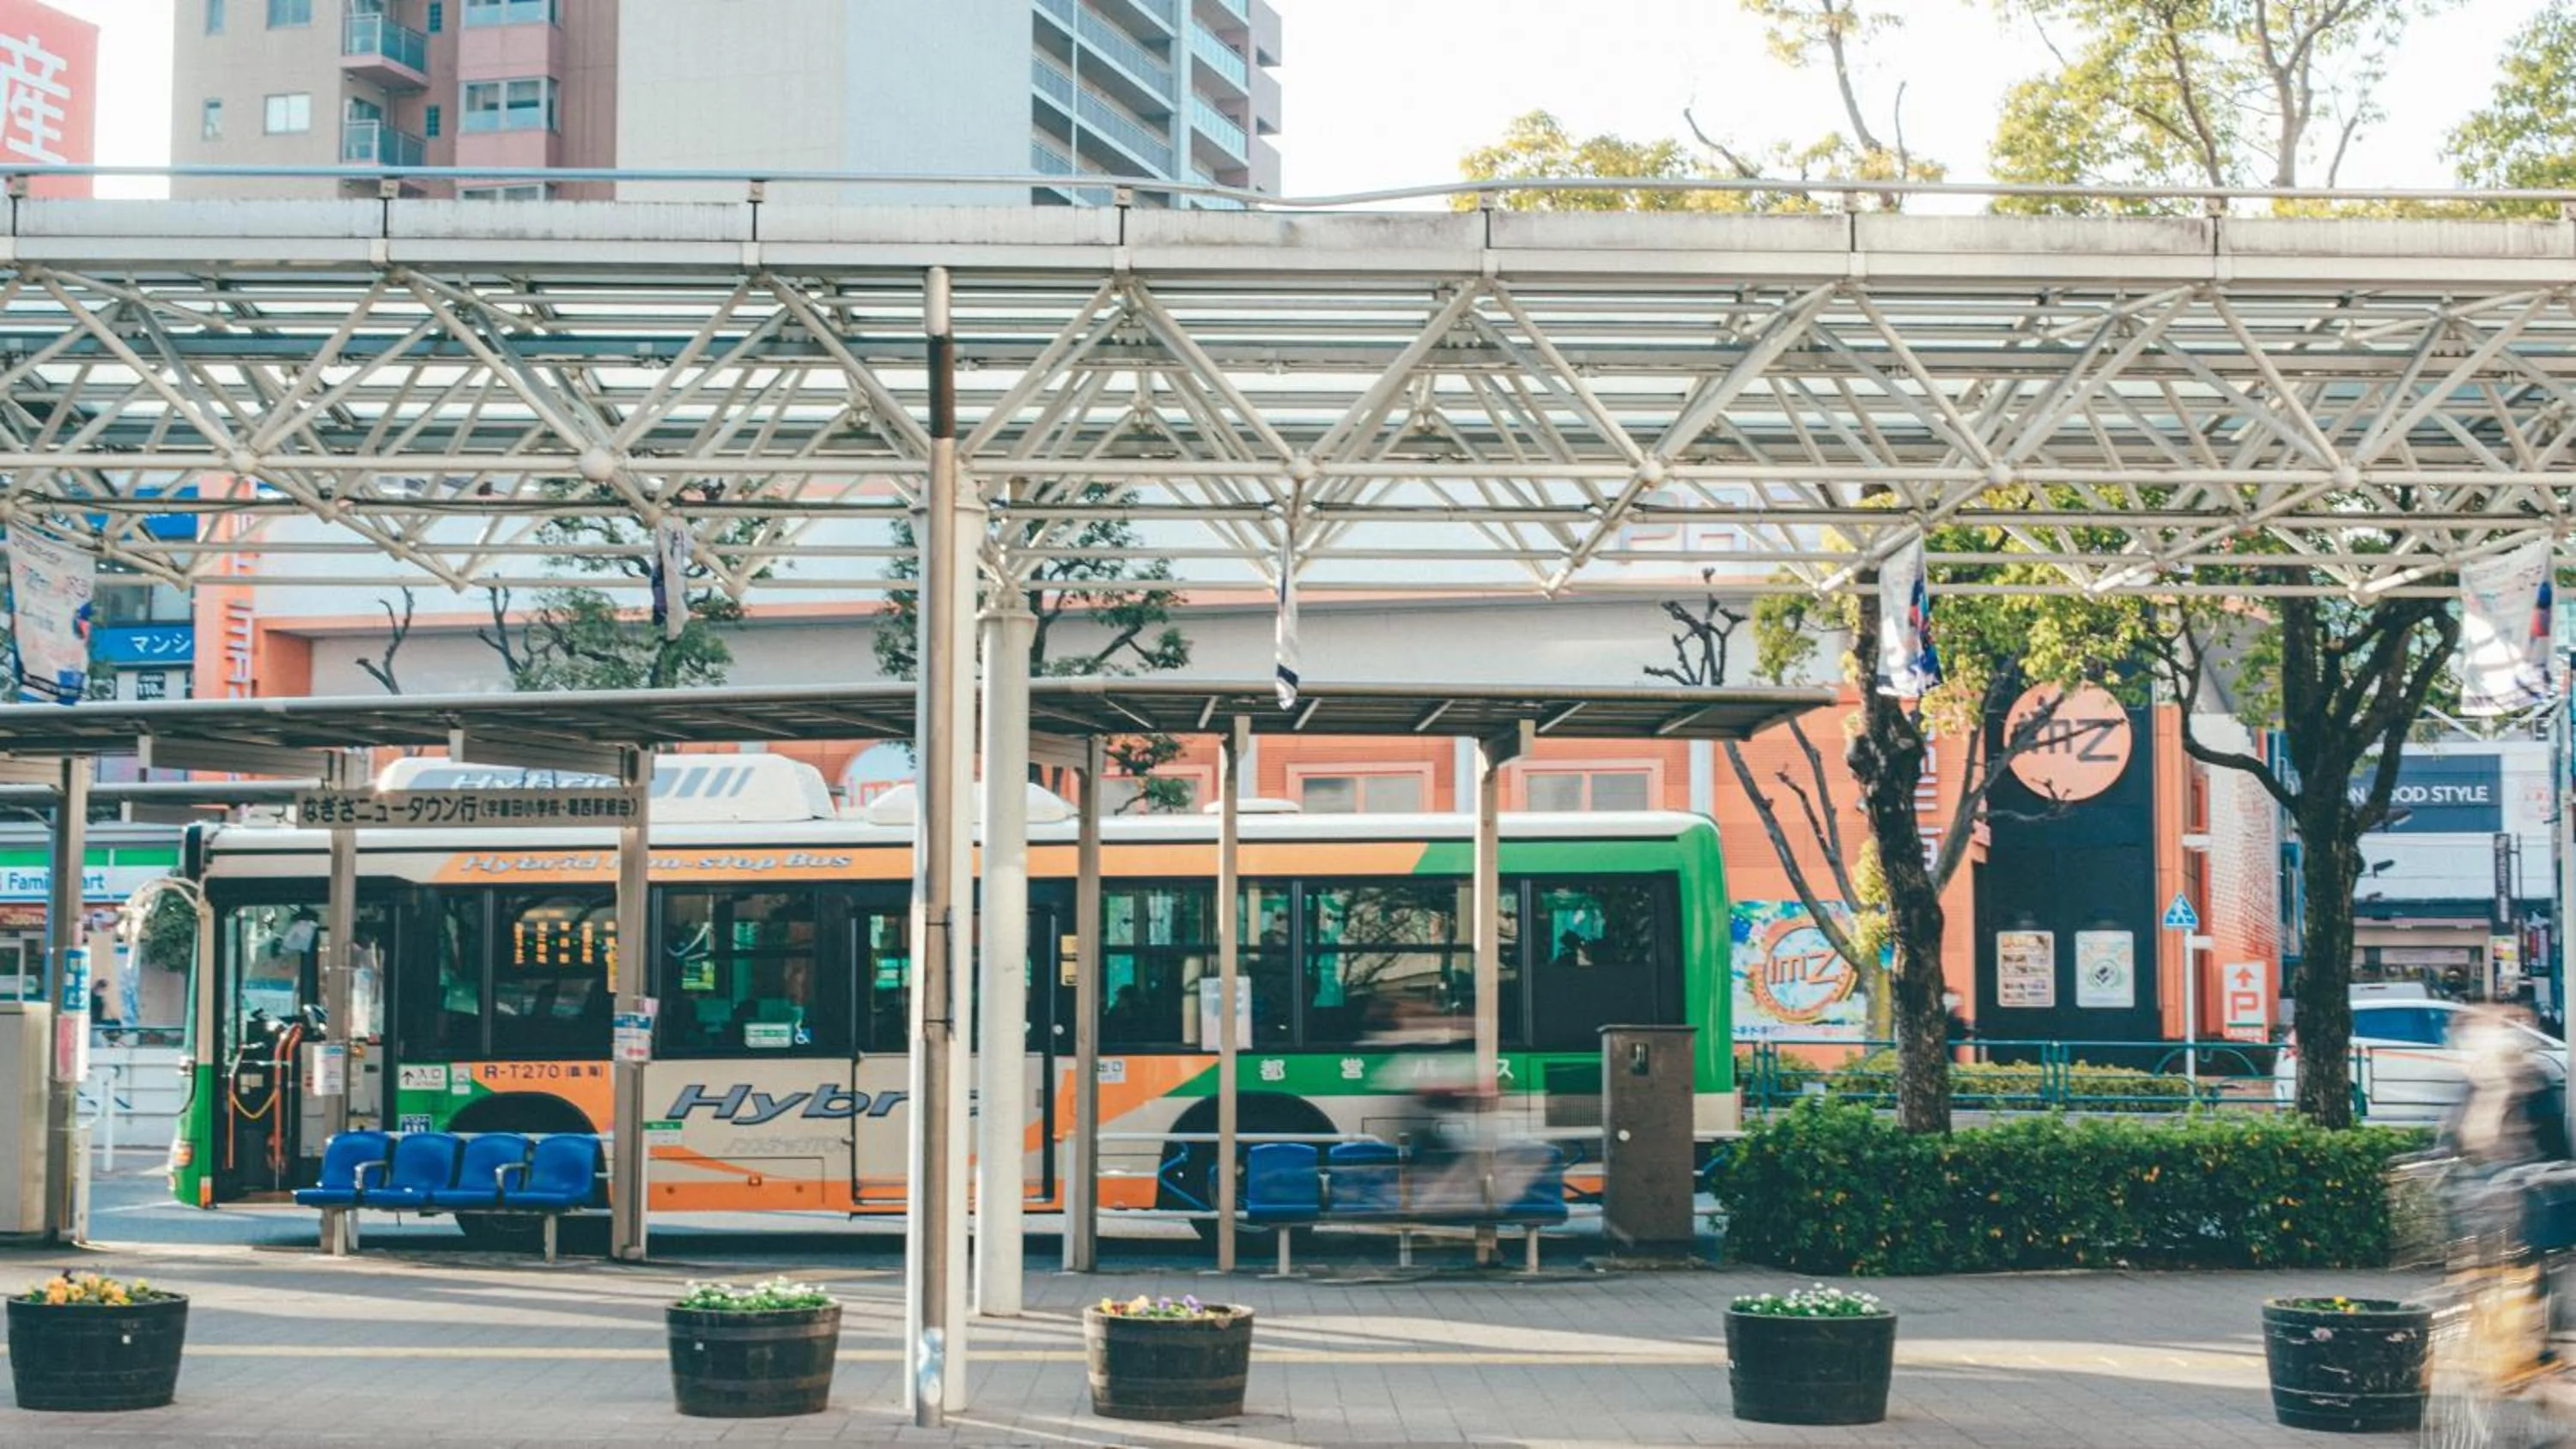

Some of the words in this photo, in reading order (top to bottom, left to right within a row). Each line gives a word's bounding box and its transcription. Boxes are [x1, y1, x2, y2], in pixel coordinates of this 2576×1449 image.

[2431, 785, 2488, 803] STYLE
[2231, 991, 2259, 1022] P
[484, 1064, 560, 1079] R-T270
